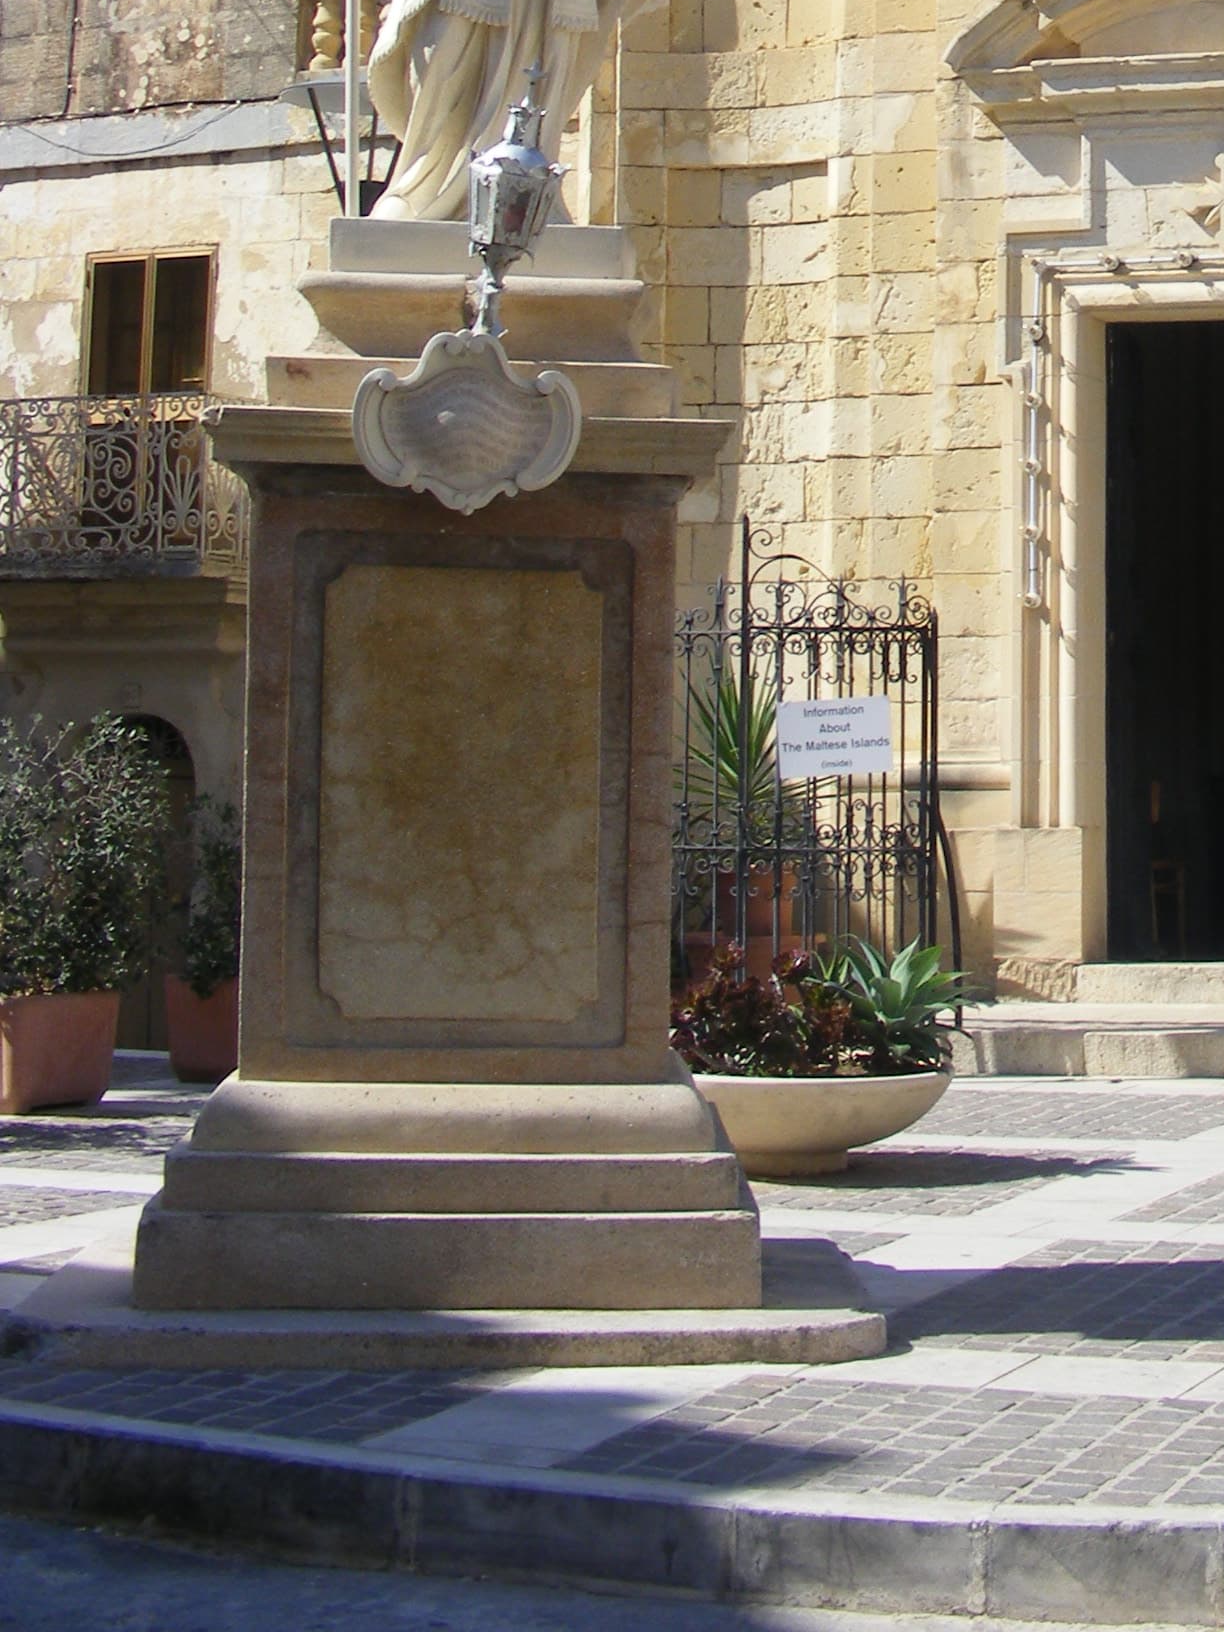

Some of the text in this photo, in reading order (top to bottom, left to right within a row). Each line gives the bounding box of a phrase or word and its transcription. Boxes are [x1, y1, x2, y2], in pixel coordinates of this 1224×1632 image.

[803, 706, 864, 718] Information
[819, 723, 851, 733] About
[782, 736, 890, 752] The Maltese Islands
[821, 760, 853, 769] (inside)
